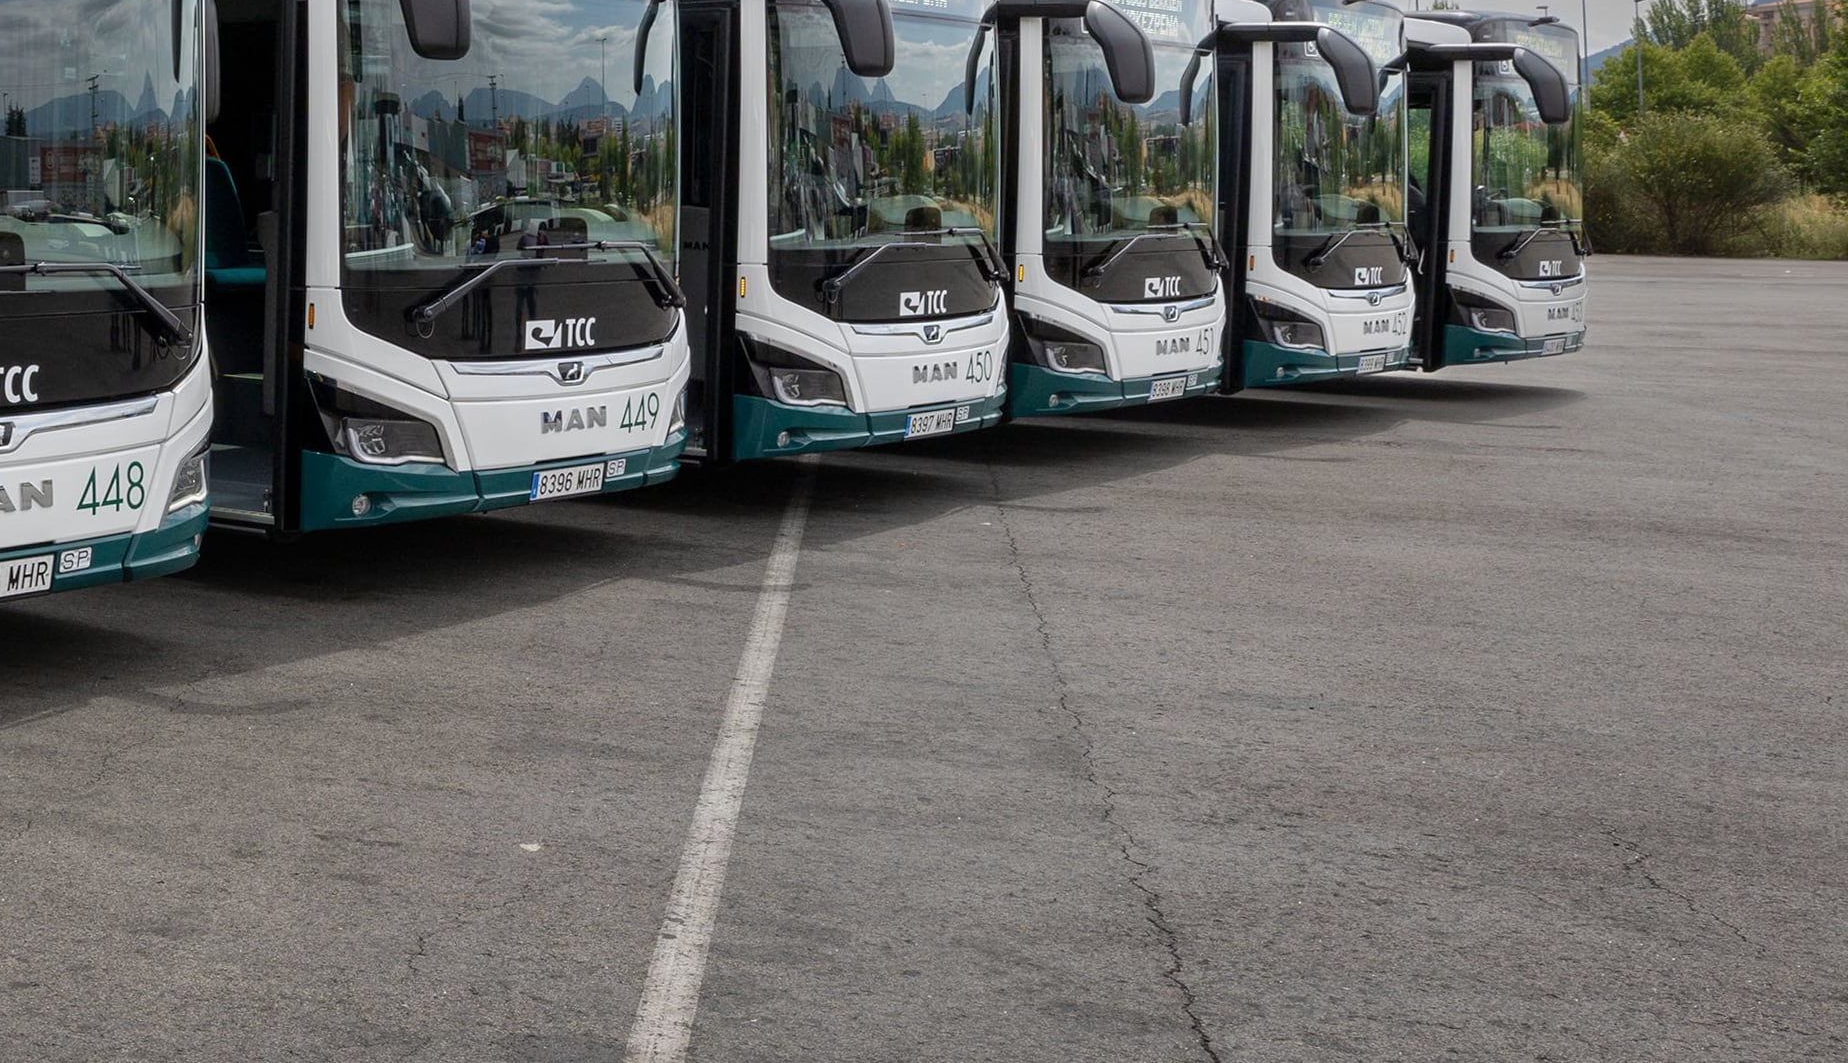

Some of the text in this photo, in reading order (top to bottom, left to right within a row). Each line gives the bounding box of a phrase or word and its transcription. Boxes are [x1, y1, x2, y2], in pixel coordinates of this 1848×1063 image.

[1165, 276, 1181, 296] TCC
[1370, 266, 1383, 285] TCC
[927, 290, 948, 314] TCC
[566, 317, 596, 348] TCC
[1363, 319, 1389, 335] MAN
[1156, 328, 1214, 356] MAN 451
[912, 350, 993, 385] MAN 450
[540, 392, 660, 434] MAN 449
[910, 412, 953, 435] 8397 MHR
[956, 407, 969, 420] SP
[607, 460, 626, 475] SP
[75, 460, 146, 516] 448
[539, 467, 602, 495] 8396 MHR
[62, 549, 90, 569] SP
[7, 561, 49, 591] MHR
